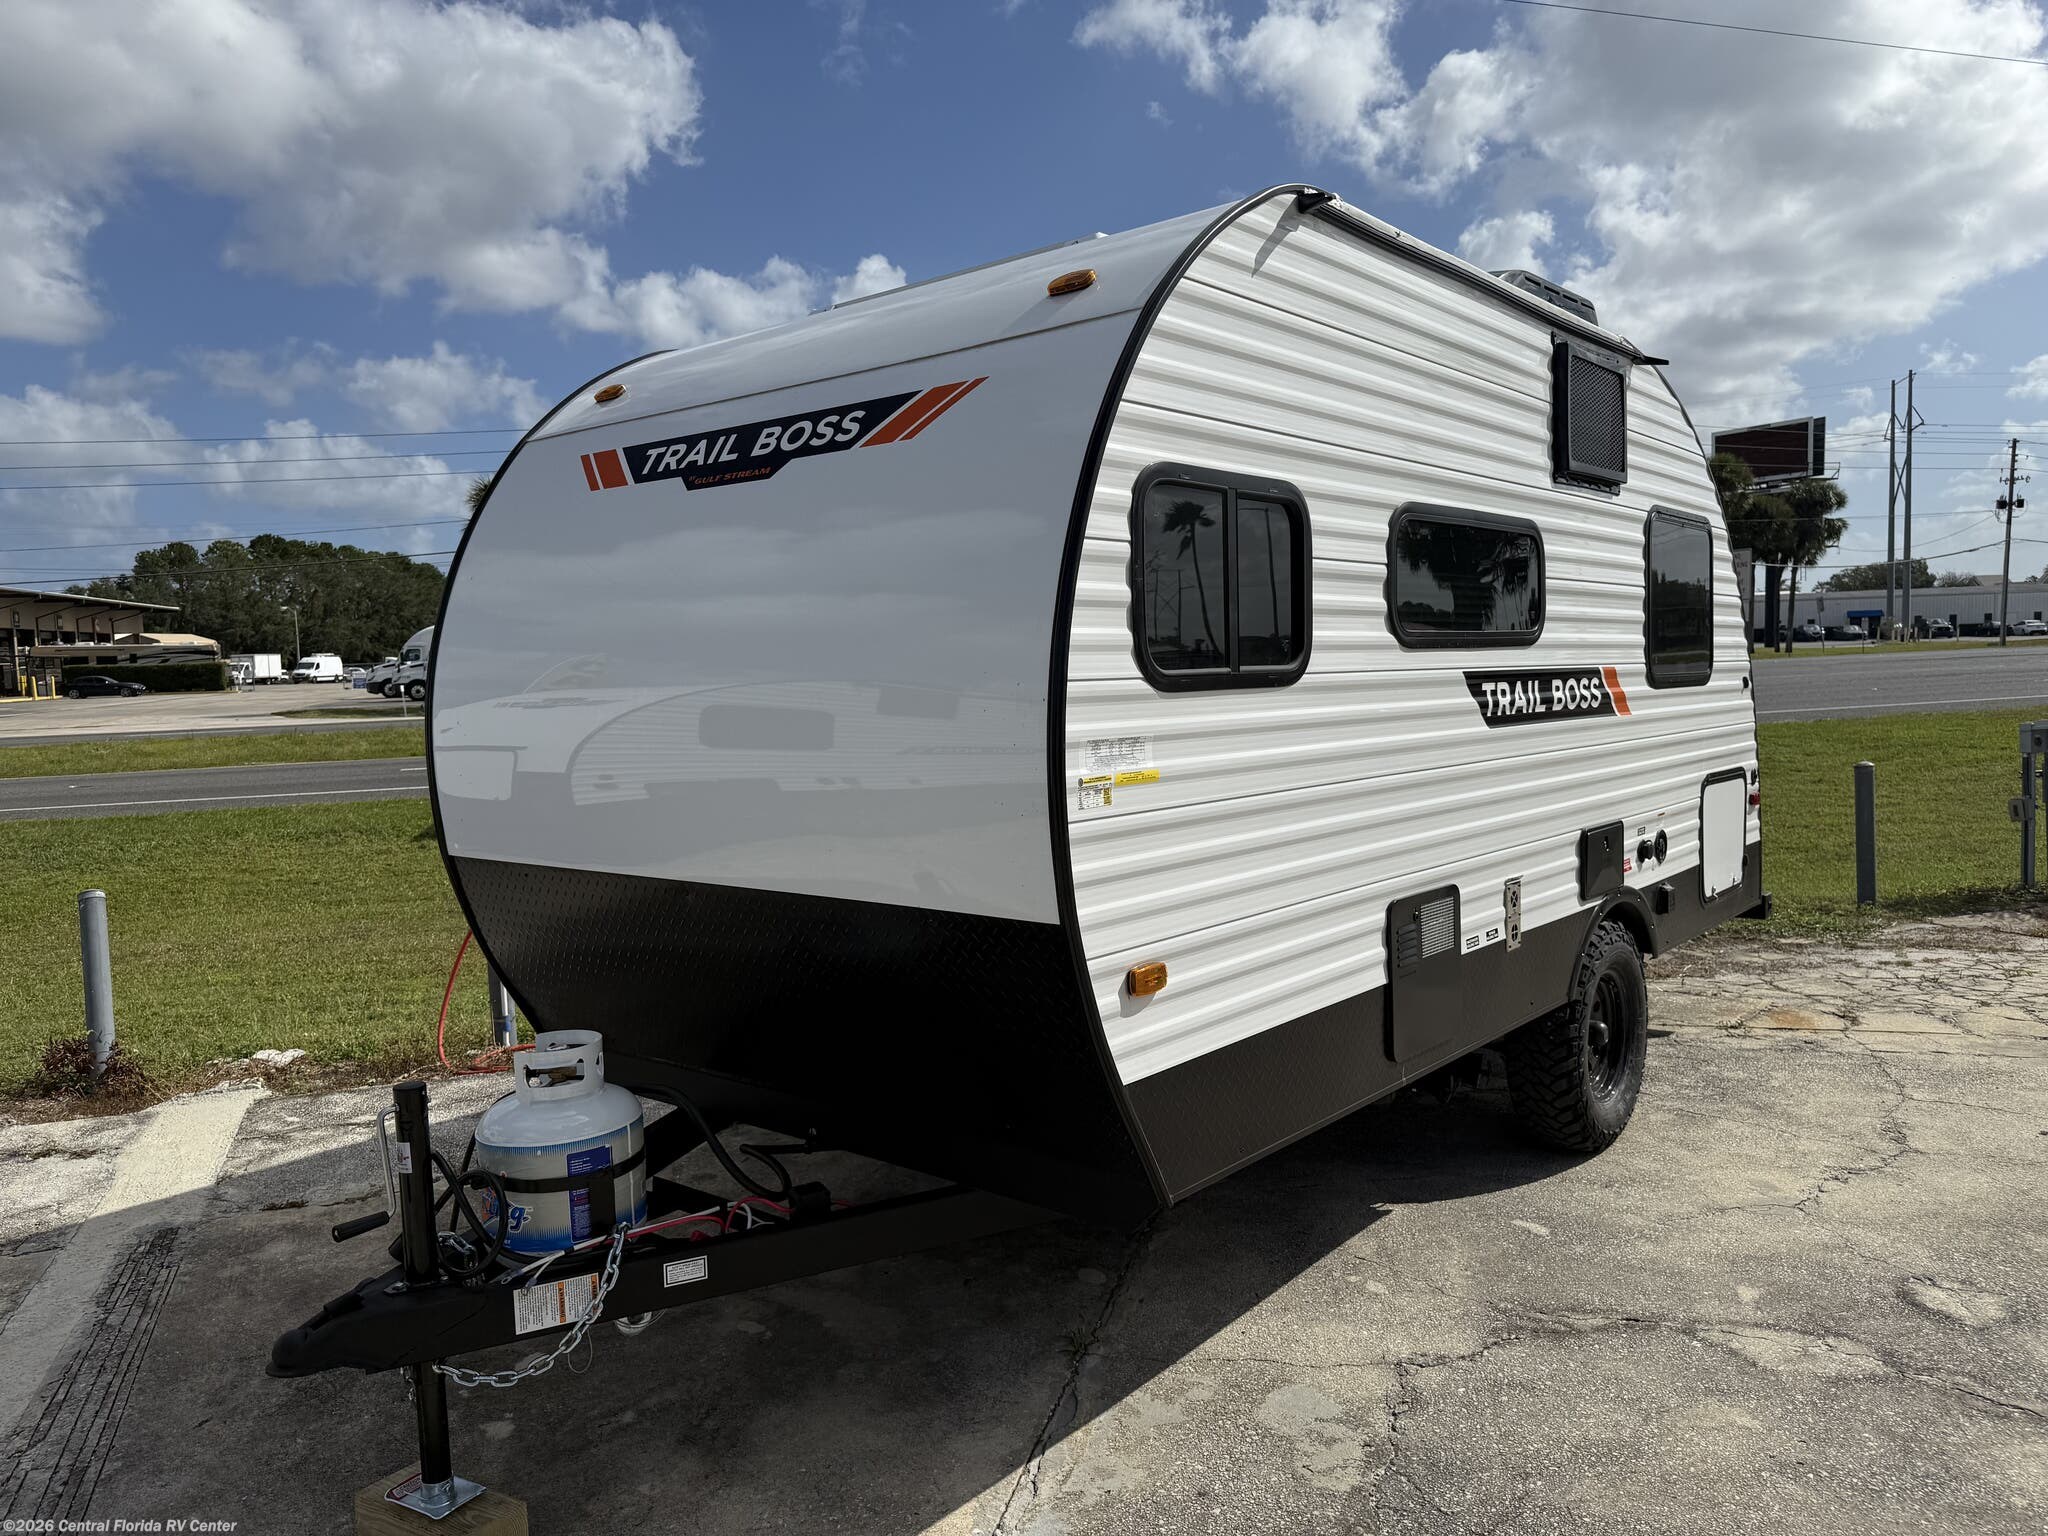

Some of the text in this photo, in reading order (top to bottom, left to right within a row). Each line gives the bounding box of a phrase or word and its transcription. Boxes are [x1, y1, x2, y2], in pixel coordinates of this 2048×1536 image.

[641, 410, 866, 475] TRAIL BOSS
[694, 475, 723, 485] GULF
[723, 466, 771, 480] STREAM
[1481, 677, 1602, 717] TRAIL BOSS
